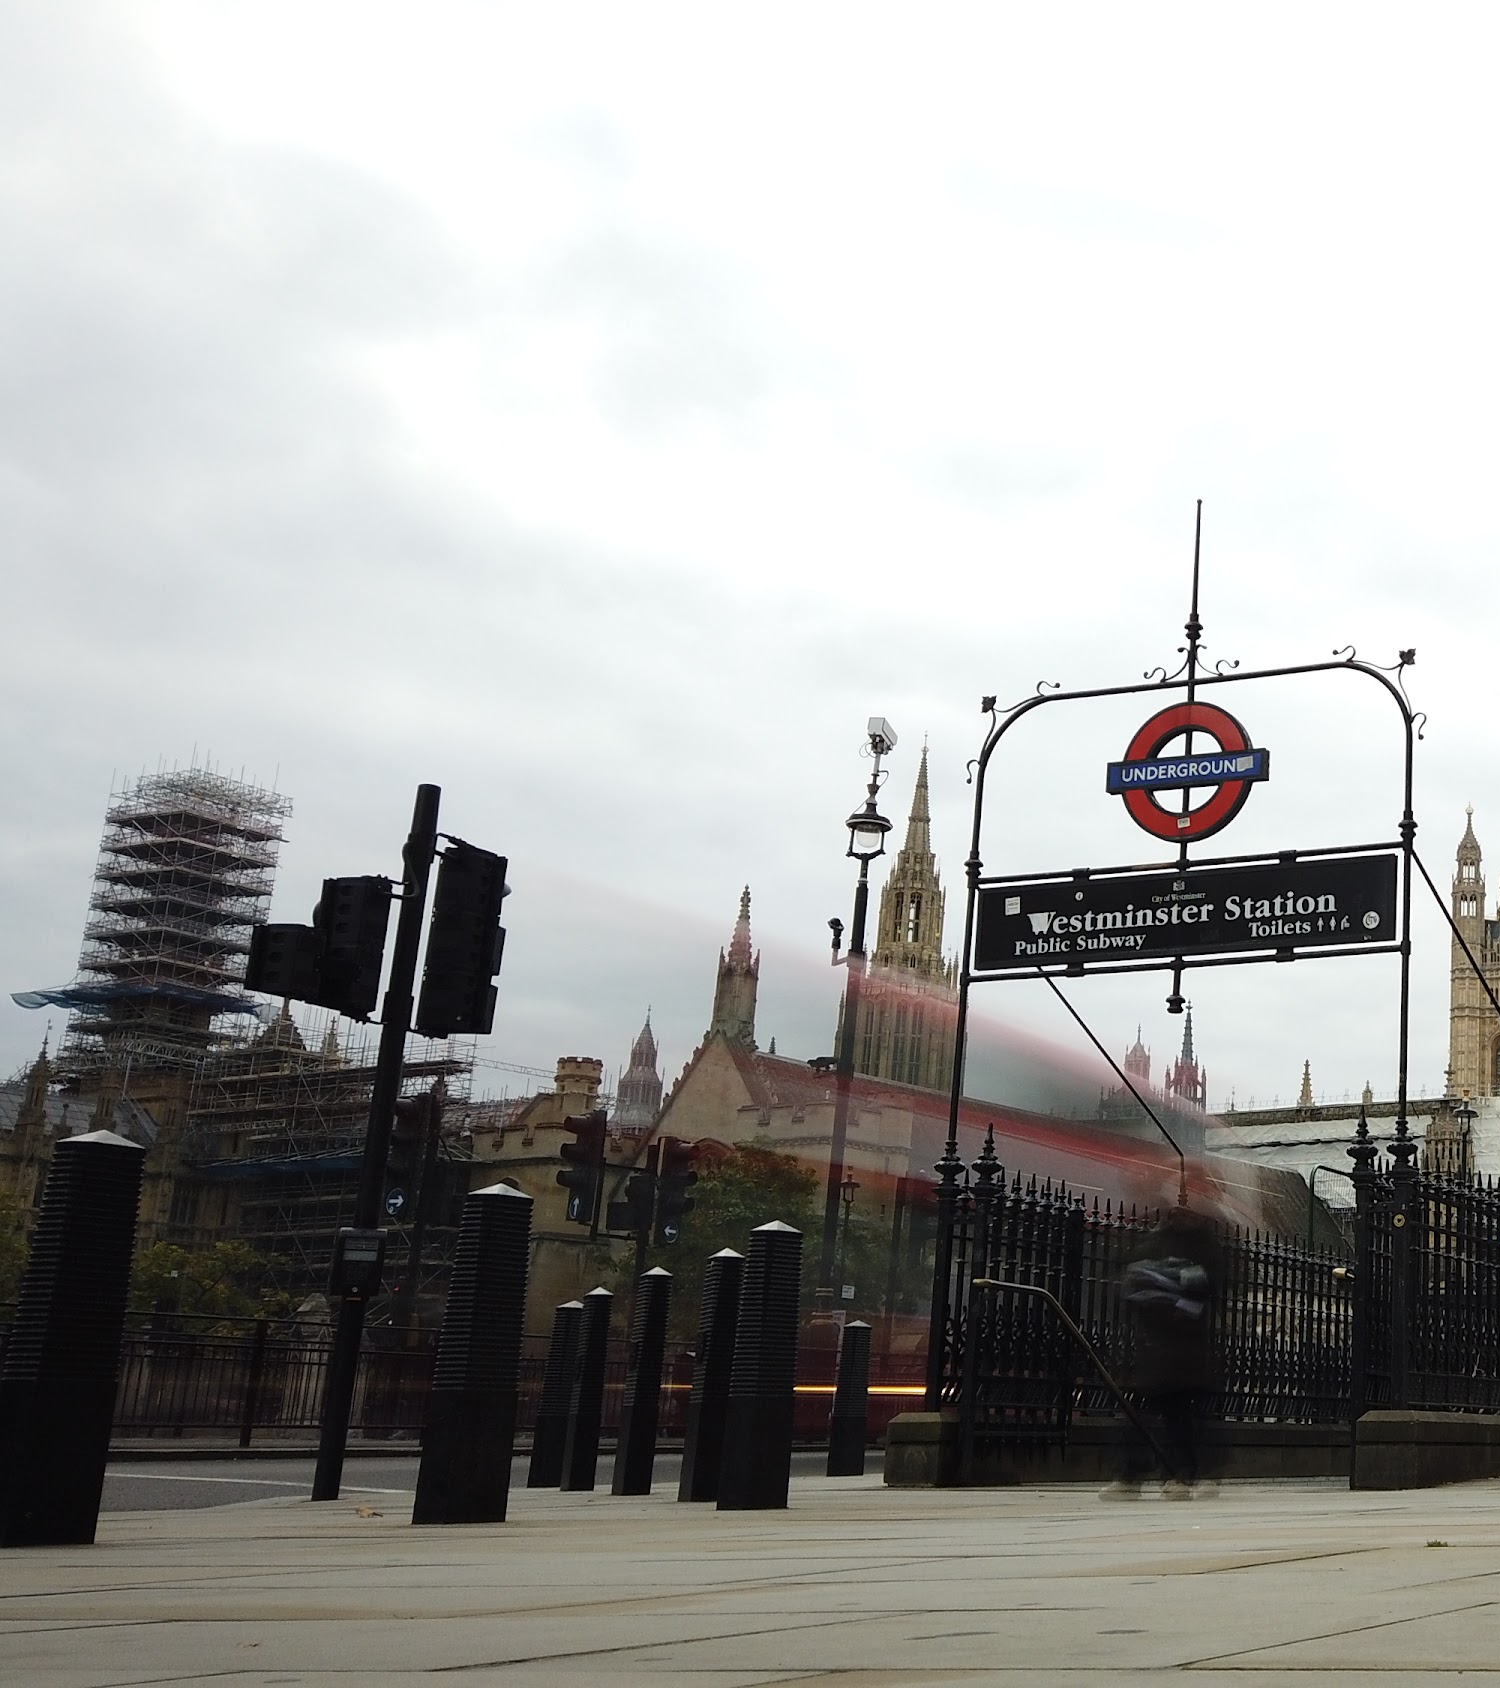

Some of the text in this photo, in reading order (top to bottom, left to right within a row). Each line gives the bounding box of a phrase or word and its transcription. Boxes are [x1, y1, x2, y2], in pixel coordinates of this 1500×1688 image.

[1121, 758, 1247, 783] UNDERGROUN
[1026, 903, 1215, 936] Westminster
[1224, 890, 1337, 921] Station
[1248, 919, 1312, 938] Toilets
[1014, 934, 1147, 956] Public Subway
